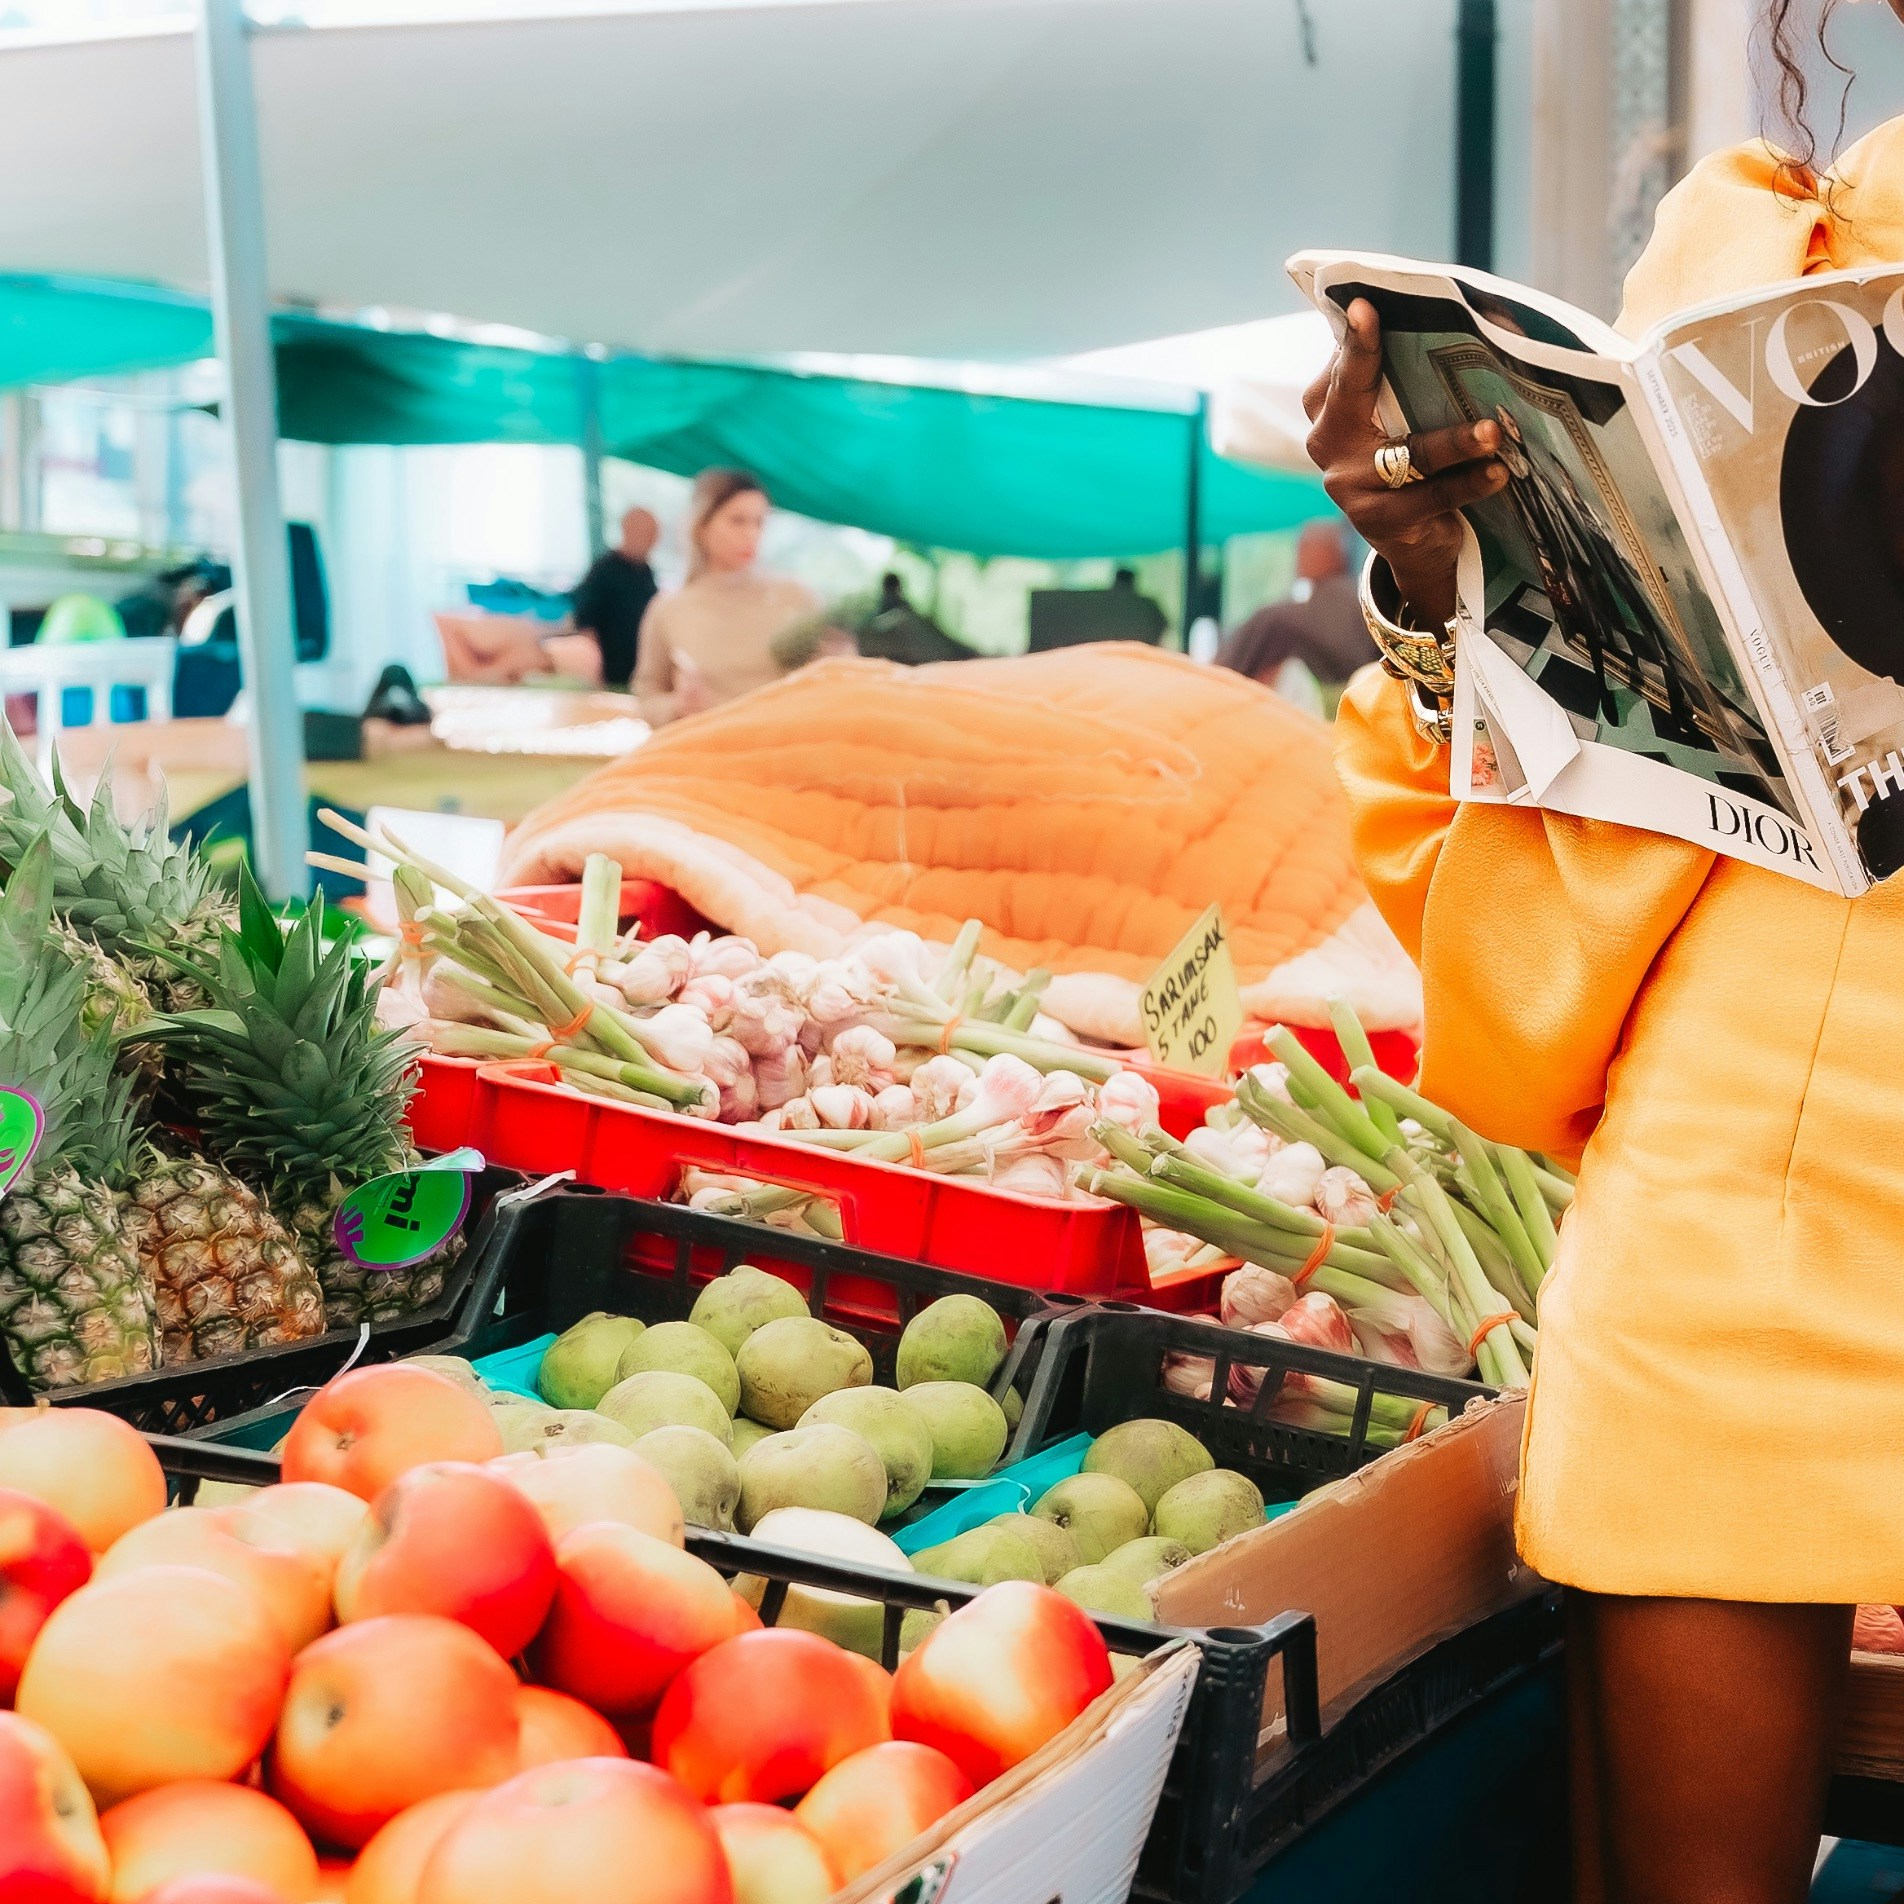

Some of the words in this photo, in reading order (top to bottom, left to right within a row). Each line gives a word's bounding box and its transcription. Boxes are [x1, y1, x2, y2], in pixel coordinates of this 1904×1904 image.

[1797, 341, 1847, 363] BRITISH
[1750, 628, 1772, 673] VOGUE
[1704, 791, 1823, 873] DIOR
[1144, 916, 1225, 1032] SARIMSAK
[1188, 1014, 1217, 1061] 100
